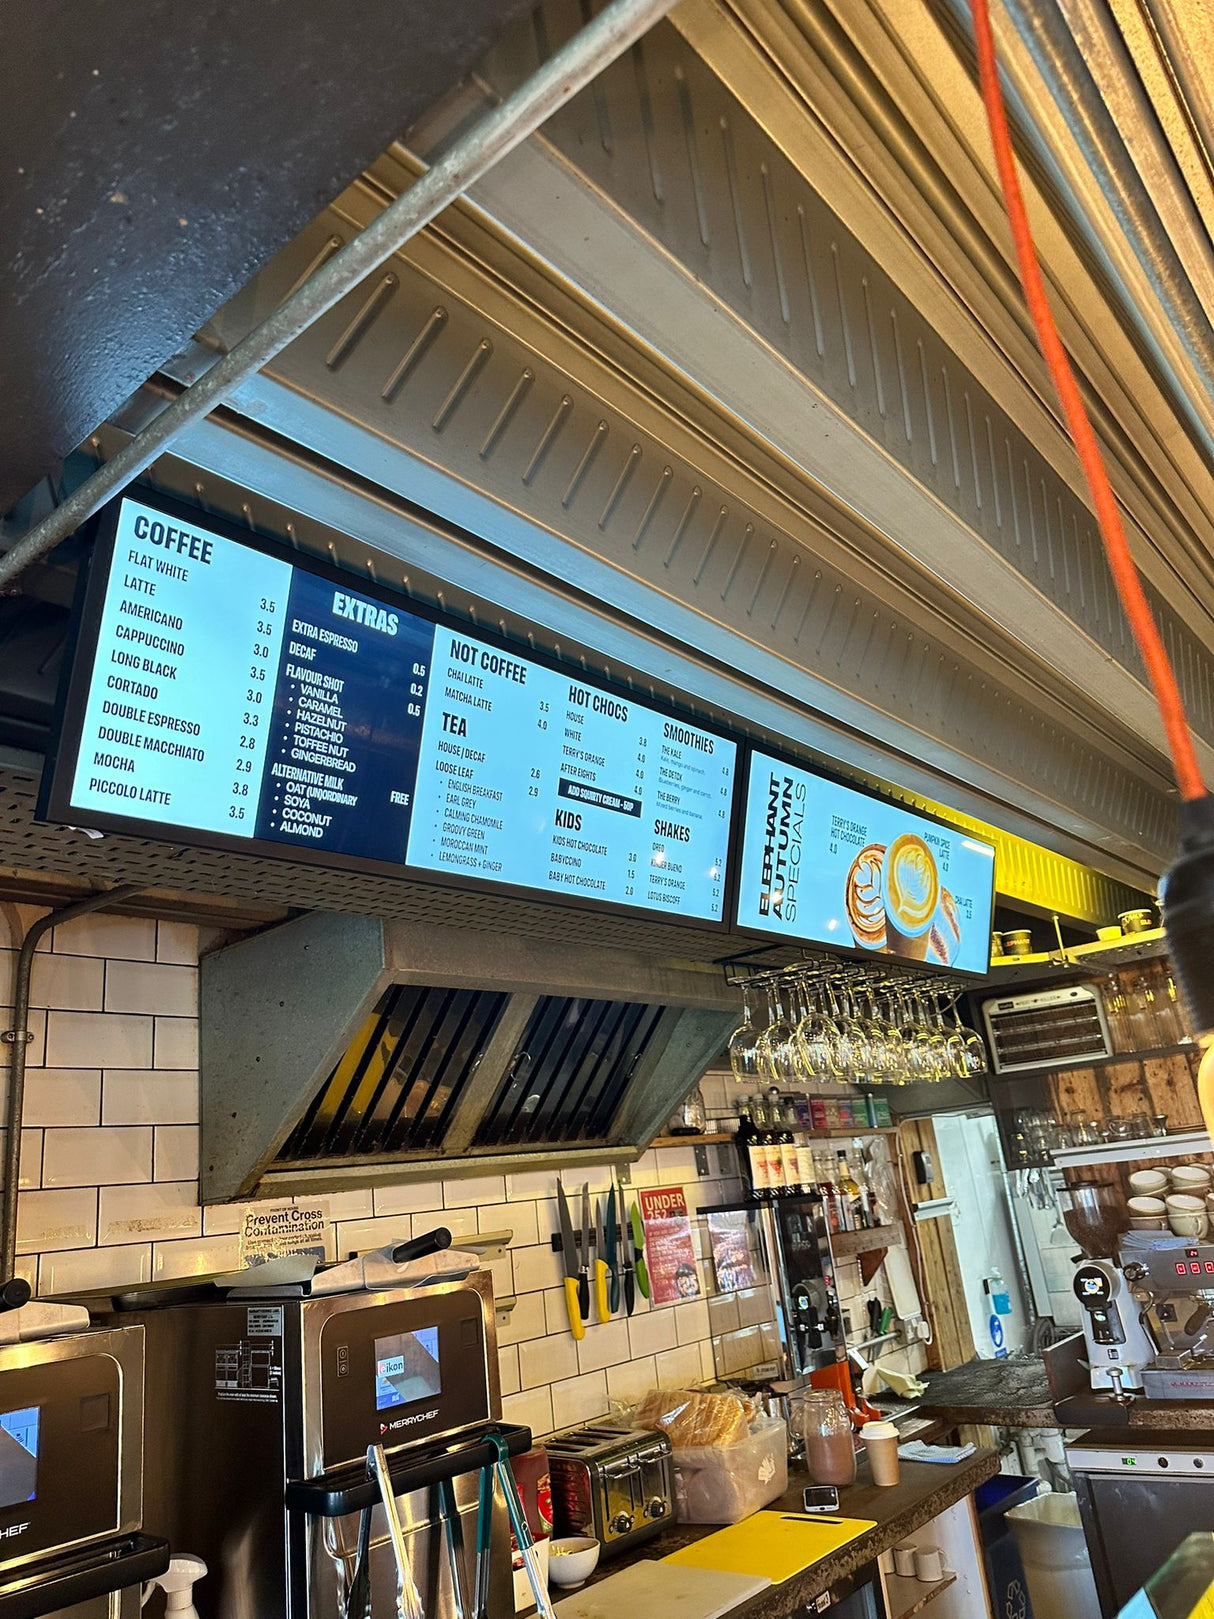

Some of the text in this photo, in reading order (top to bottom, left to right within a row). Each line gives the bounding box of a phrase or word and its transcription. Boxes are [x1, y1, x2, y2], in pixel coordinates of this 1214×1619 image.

[133, 515, 213, 564] COFFEE
[128, 549, 275, 613] FLAT WHITE 3.5
[123, 574, 272, 635] LATTE 3.5
[332, 591, 398, 635] EXTRAS
[119, 599, 268, 658] AMERICANO 3.0
[115, 624, 265, 681] CAPPUCCINO 3.5
[291, 618, 425, 676] EXTRA ESPRESSO 0.5
[288, 641, 423, 696] DECAF 0.2
[449, 638, 526, 684] NOT COFFEE
[111, 649, 262, 703] LONG BLACK 3.0
[106, 675, 258, 726] CORTADO 3.3
[285, 663, 420, 716] FLAVOUR SHOT 0.5
[300, 683, 338, 704] VANILLA
[447, 667, 549, 712] CHAI LATTE 3.5
[298, 696, 342, 718] CARAMEL
[444, 686, 547, 730] MATCHA LATTE 4.0
[568, 684, 628, 722] HOT CHOCS
[102, 700, 255, 749] DOUBLE ESPRESSO 2.8
[296, 708, 346, 731] HAZELNUT
[442, 712, 466, 737] TEA
[566, 710, 583, 724] HOUSE
[294, 721, 343, 743] PISTACHIO
[564, 727, 581, 741] WHITE
[663, 722, 713, 754] SMOOTHIES
[97, 725, 251, 772] DOUBLE MACCHIATO 2.9
[293, 734, 348, 757] TOFFEE NUT
[562, 744, 584, 760] TERRY'S
[584, 752, 605, 766] ORANGE
[661, 744, 670, 755] THE
[670, 748, 681, 759] KALE
[290, 747, 356, 772] GINGERBREAD
[437, 740, 460, 756] HOUSE
[464, 748, 485, 762] DECAF
[530, 767, 540, 779] 2.6
[93, 751, 248, 796] MOCHA 3.8
[435, 759, 538, 796] LOOSE LEAF 2.9
[560, 762, 577, 775] AFTER
[577, 767, 596, 781] EIGHTS
[659, 766, 668, 777] THE
[271, 762, 409, 805] ALTERNATIVE MILK FREE
[285, 781, 357, 806] OAT (UN)ORDINARY
[447, 778, 502, 801] ENGLISH BREAKFAST
[89, 777, 244, 819] PICCOLO LATTE 3.5
[283, 794, 310, 809] SOYA
[445, 793, 476, 809] EARL GREY
[567, 784, 580, 796] ADD
[579, 788, 602, 802] SQUIRTY
[602, 794, 620, 808] CREAM
[657, 790, 665, 800] THE
[666, 793, 680, 804] BERRY
[281, 807, 332, 826] COCONUT
[444, 807, 502, 830] CALMING CHAMOMILE
[554, 808, 581, 831] KIDS
[280, 820, 323, 837] ALMOND
[442, 821, 485, 840] GROOVY GREEN
[653, 818, 690, 842] SHAKES
[830, 827, 840, 838] HOT
[850, 821, 867, 836] ORANGE
[440, 836, 487, 854] MOROCCAN MINT
[552, 834, 565, 846] KIDS
[566, 837, 577, 848] HOT
[577, 840, 607, 856] CHOCOLATE
[652, 841, 664, 852] OREO
[759, 771, 779, 916] ELEPHANT
[772, 776, 793, 920] AUTUMN
[785, 782, 806, 922] SPECIALS
[438, 850, 477, 867] LEMONGRASS
[482, 859, 502, 871] GINGER
[550, 852, 581, 867] BABYCCINO
[667, 862, 682, 873] BUENO
[548, 870, 563, 881] BABY
[564, 873, 575, 884] HOT
[575, 875, 605, 890] CHOCOLATE
[667, 878, 685, 889] ORANGE
[662, 893, 680, 904] BISCOFF
[644, 1192, 685, 1211] UNDER
[244, 1220, 324, 1238] Contamination
[246, 1210, 323, 1227] Prevent Cross
[379, 1361, 404, 1374] eikon
[389, 1409, 440, 1430] MERRYCHEF
